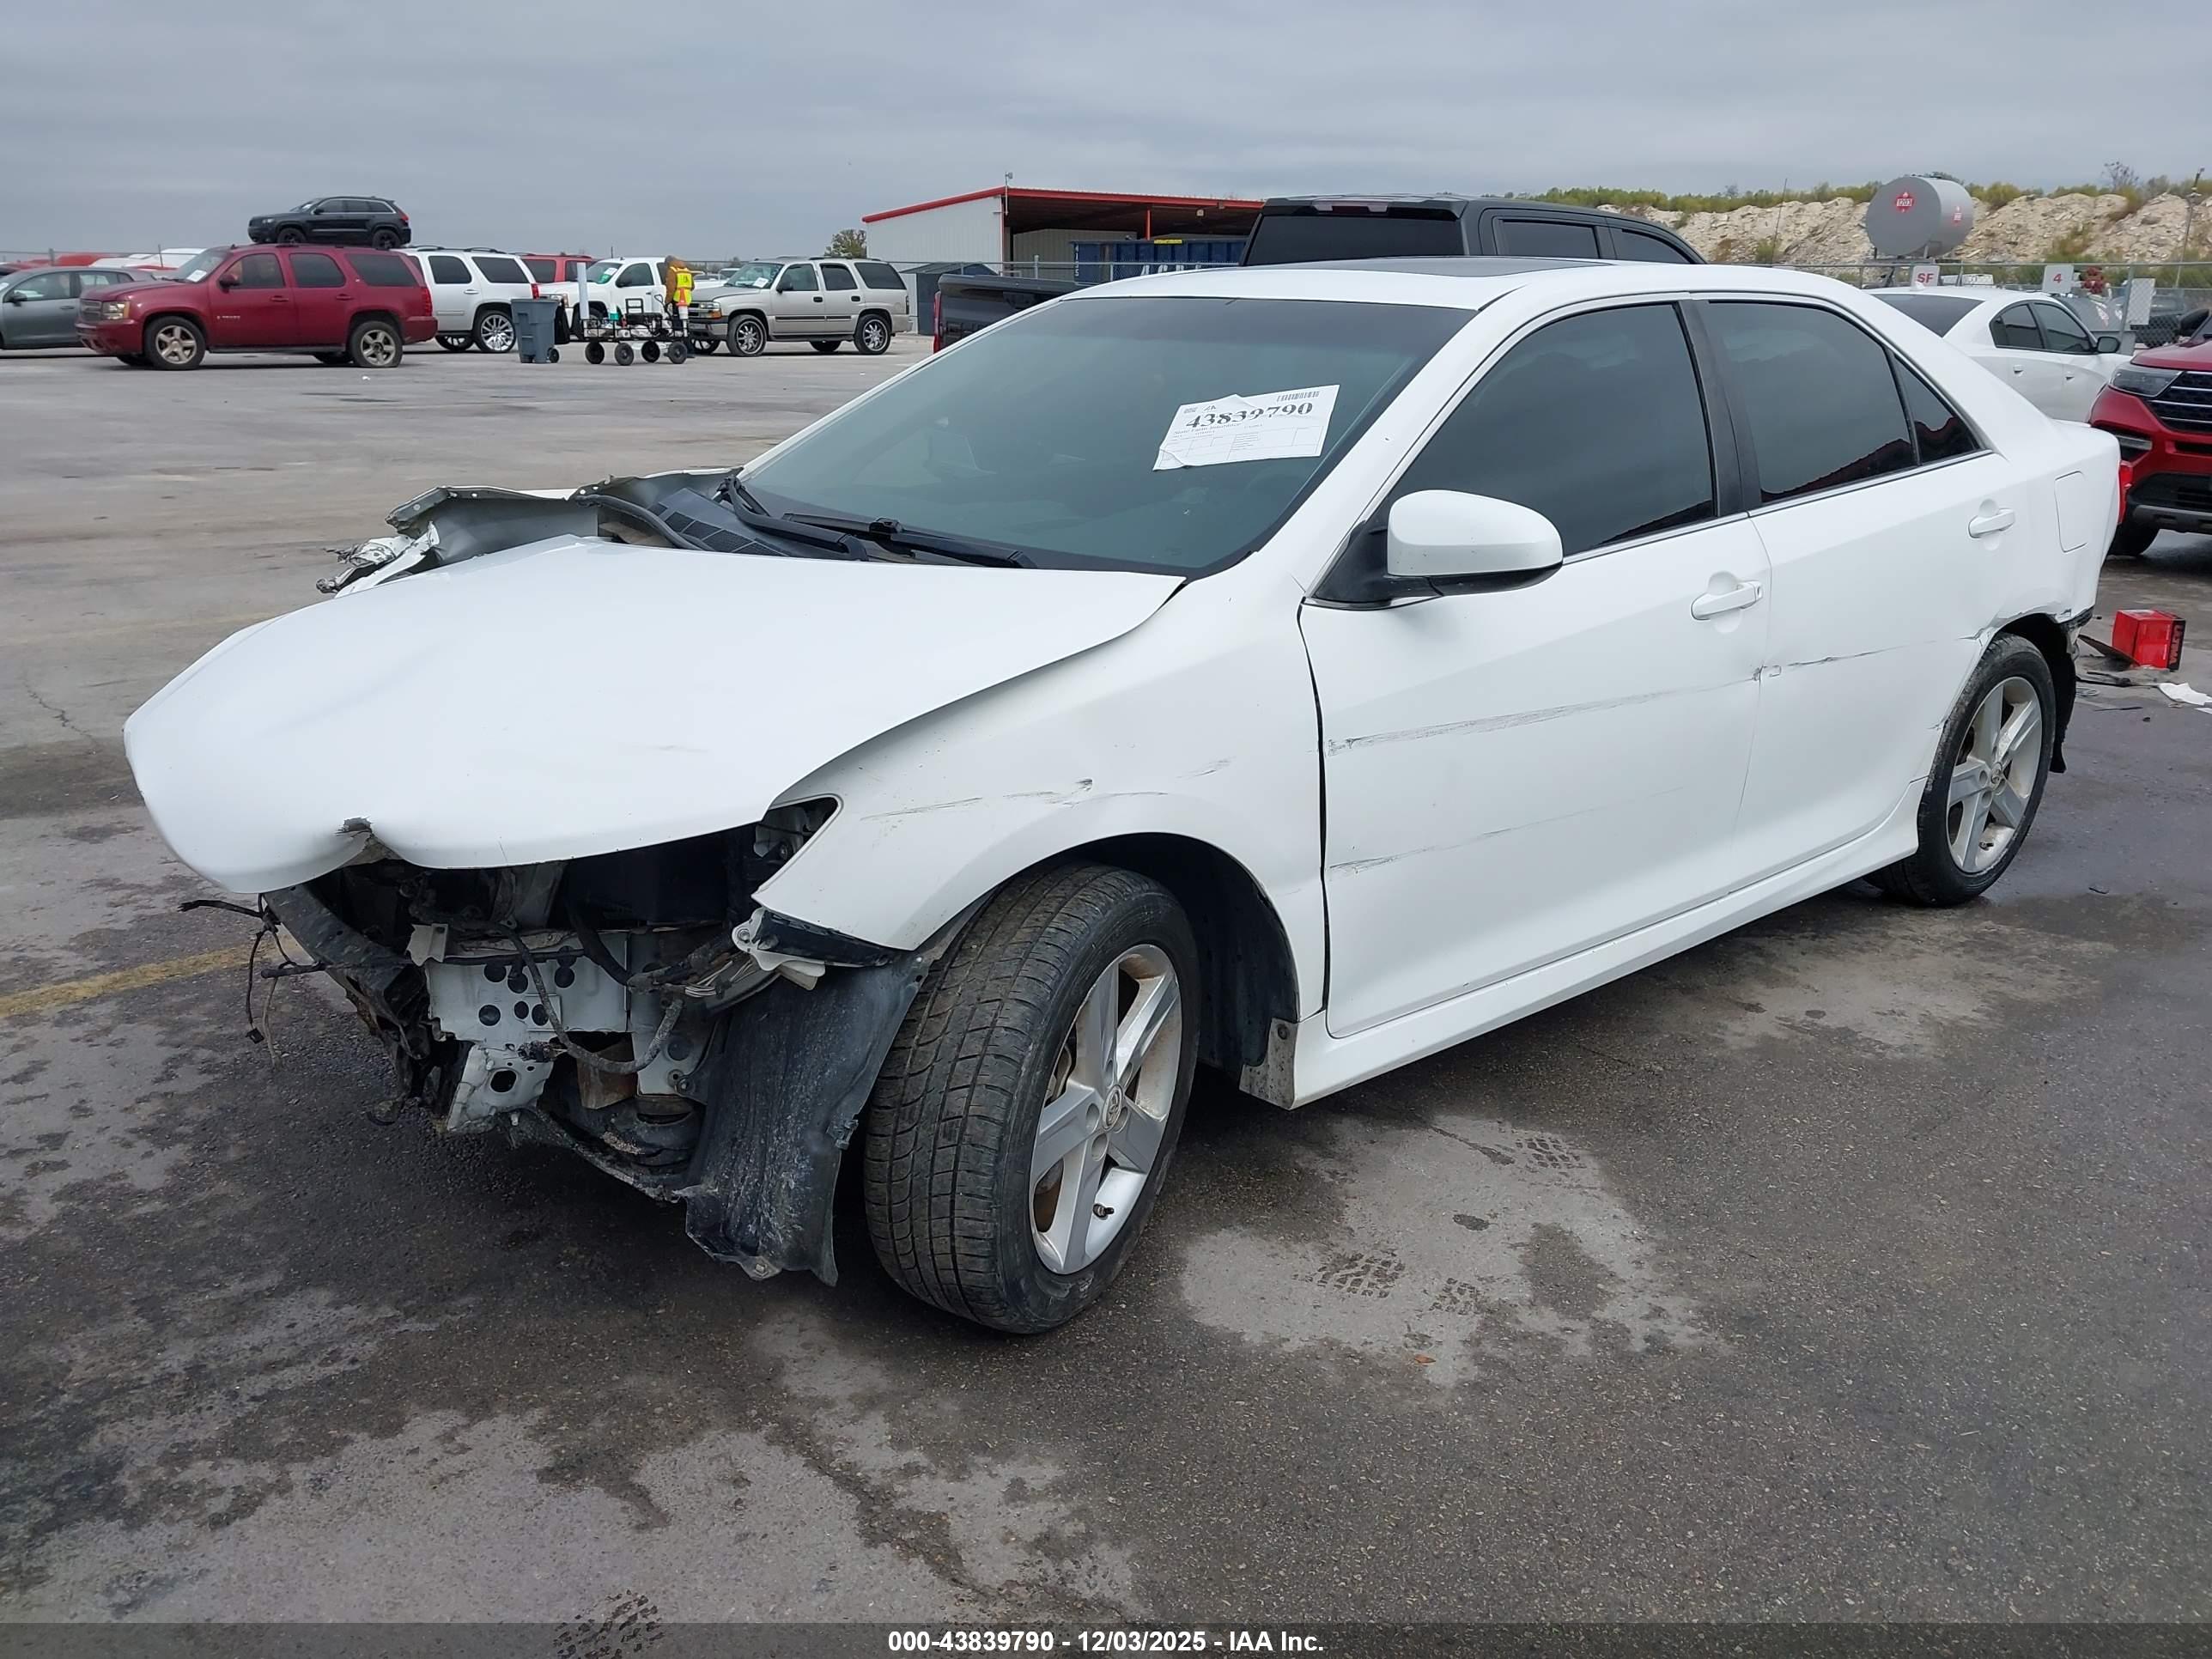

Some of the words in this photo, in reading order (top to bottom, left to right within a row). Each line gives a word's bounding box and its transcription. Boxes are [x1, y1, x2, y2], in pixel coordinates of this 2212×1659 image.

[1917, 272, 1934, 283] SF
[2053, 273, 2062, 283] 4
[1186, 402, 1313, 428] 43839790
